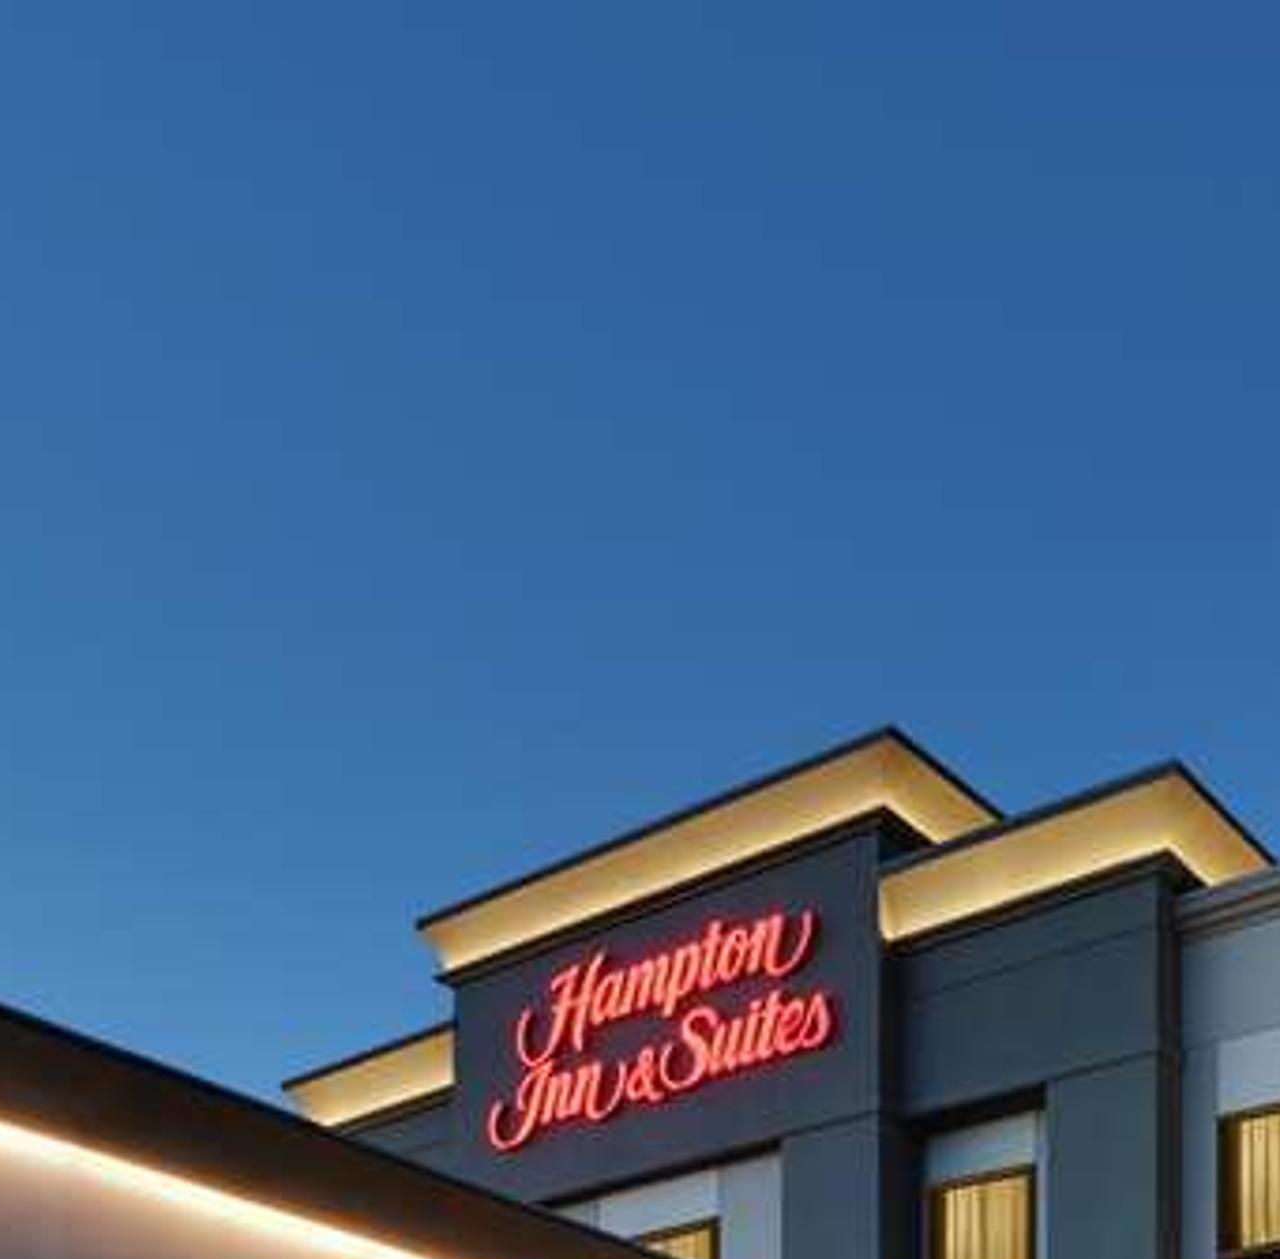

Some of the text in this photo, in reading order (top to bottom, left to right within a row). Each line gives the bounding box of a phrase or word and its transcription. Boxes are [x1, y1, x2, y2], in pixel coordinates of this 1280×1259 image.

[517, 908, 818, 1068] Hampton
[487, 990, 833, 1151] Inn & Suites
